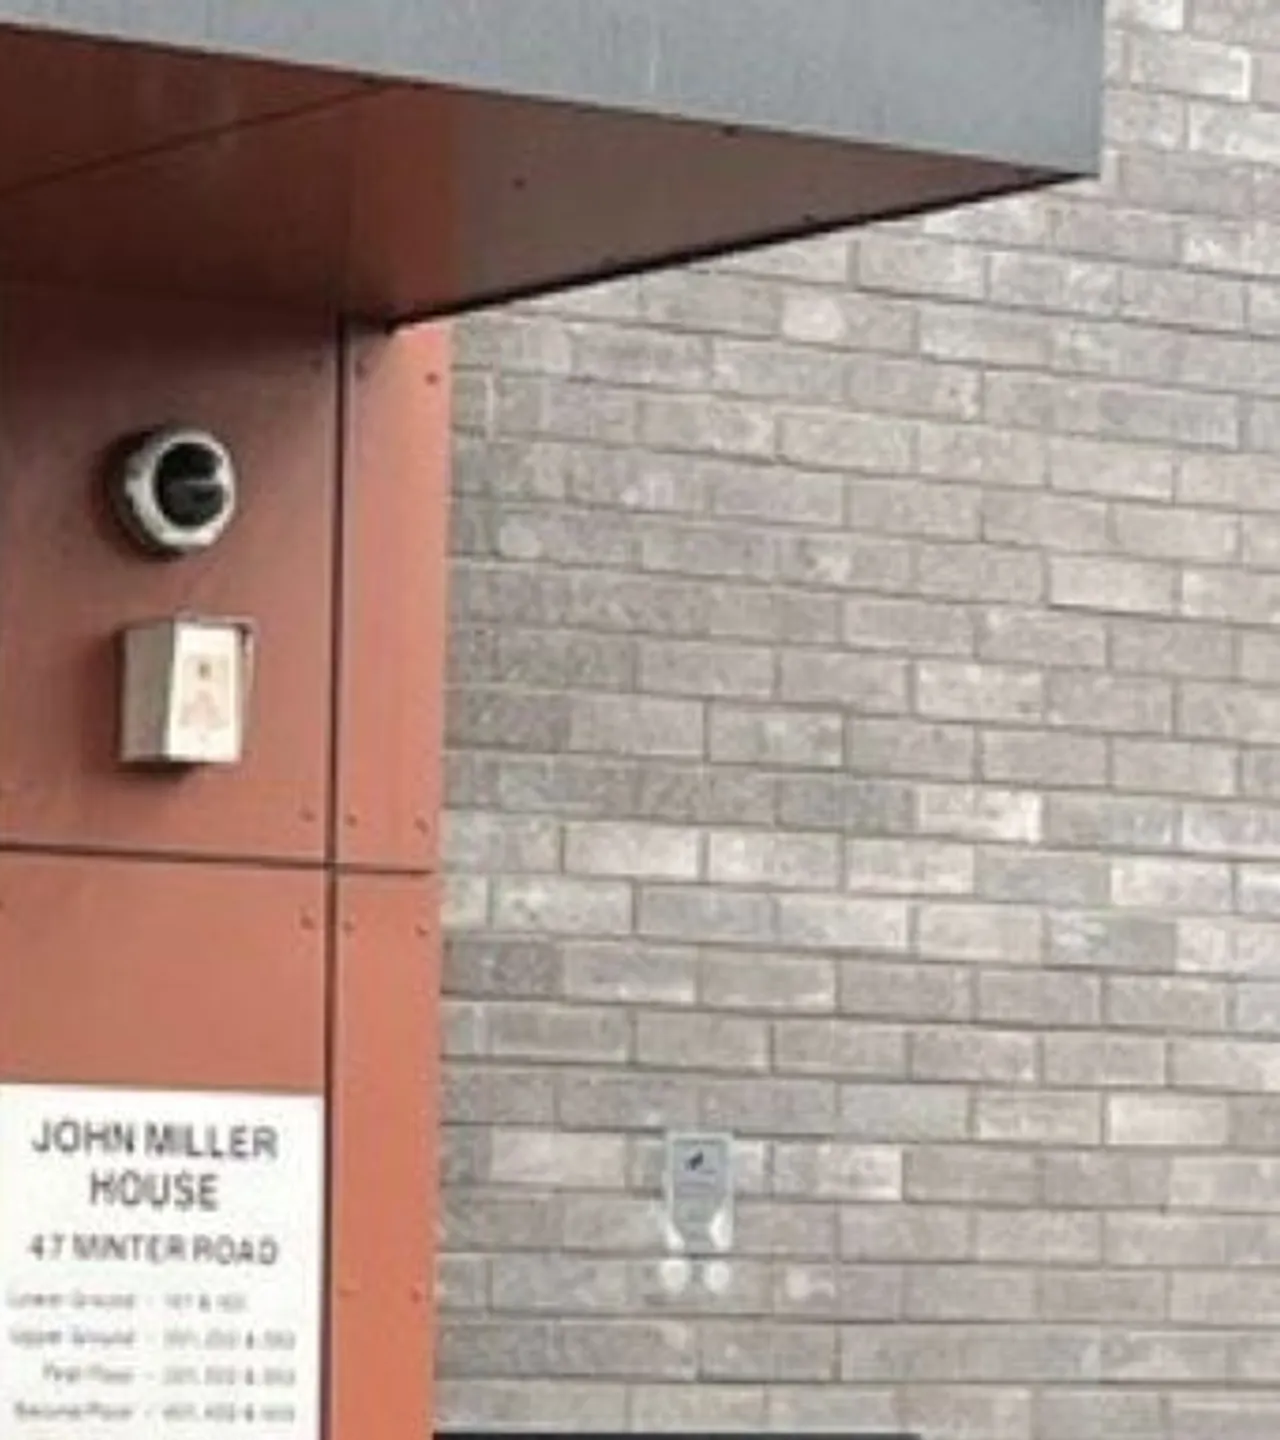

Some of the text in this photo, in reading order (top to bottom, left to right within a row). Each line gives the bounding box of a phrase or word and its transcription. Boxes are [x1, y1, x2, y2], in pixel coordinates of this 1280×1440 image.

[31, 1120, 279, 1159] JOHN MILLER
[88, 1169, 220, 1212] HOUSE
[73, 1234, 186, 1264] MINTER
[192, 1234, 279, 1265] ROAD
